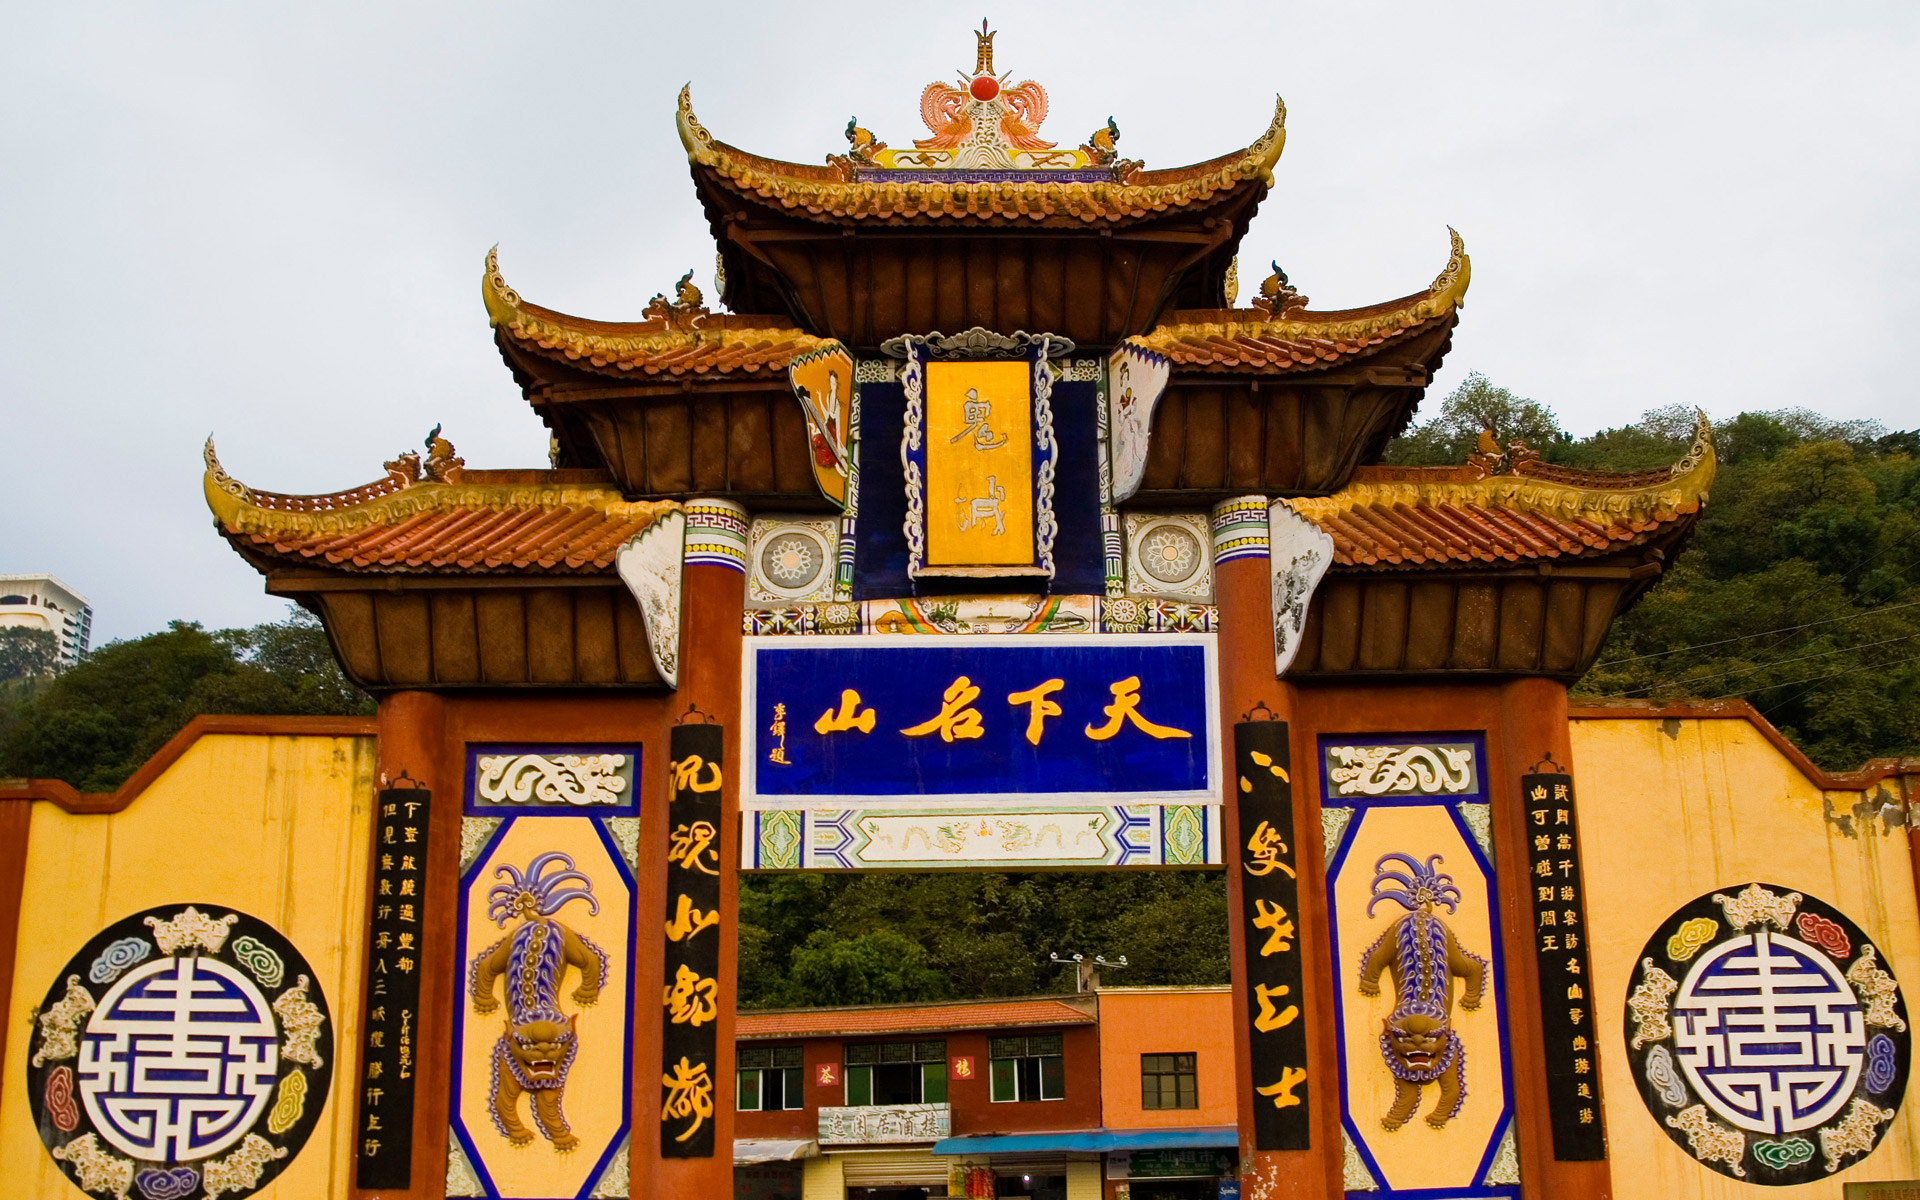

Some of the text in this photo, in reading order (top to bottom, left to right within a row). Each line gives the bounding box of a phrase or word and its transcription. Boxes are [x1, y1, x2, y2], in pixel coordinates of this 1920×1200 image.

[814, 676, 1192, 745] 天下名山
[819, 1065, 836, 1084] 茶
